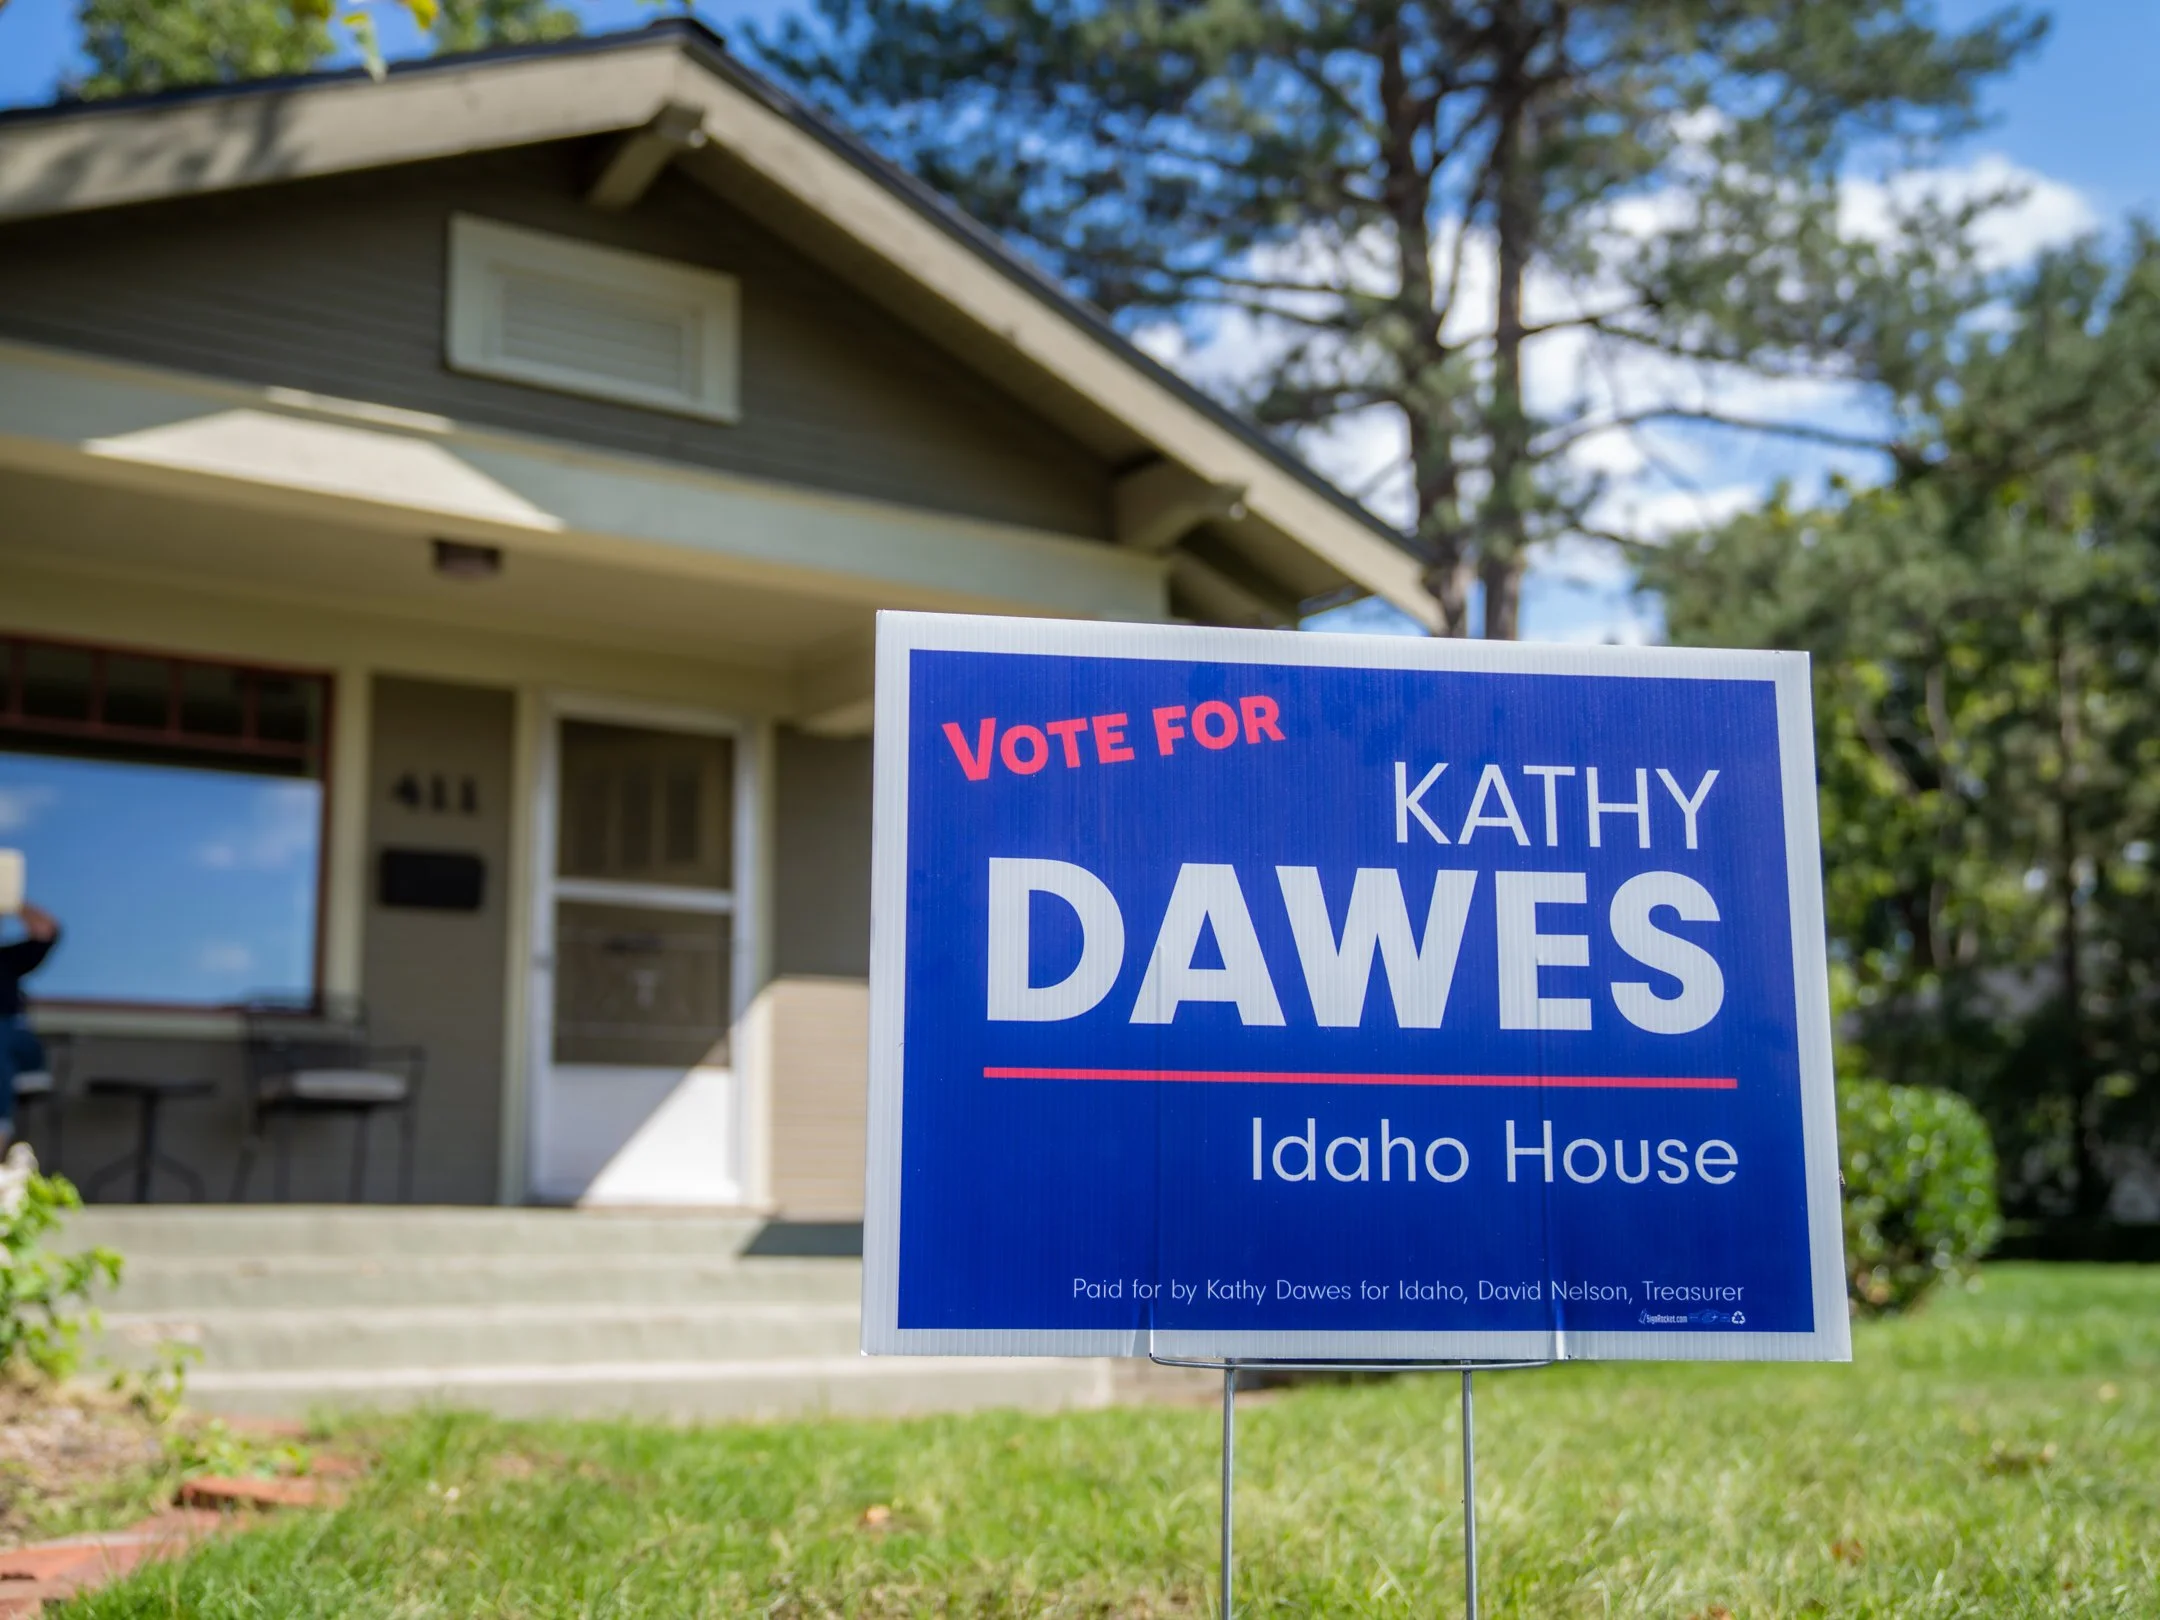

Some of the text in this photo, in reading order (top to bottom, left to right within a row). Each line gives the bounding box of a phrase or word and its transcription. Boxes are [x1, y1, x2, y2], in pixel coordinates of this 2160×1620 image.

[942, 695, 1285, 782] VOTE FOR
[1394, 761, 1720, 850] KATHY
[987, 857, 1725, 1035] DAWES
[1252, 1116, 1739, 1185] Idaho House
[1073, 1278, 1745, 1305] Paid for by Kathy Dawes for Idaho, David Nelson, Treasurer
